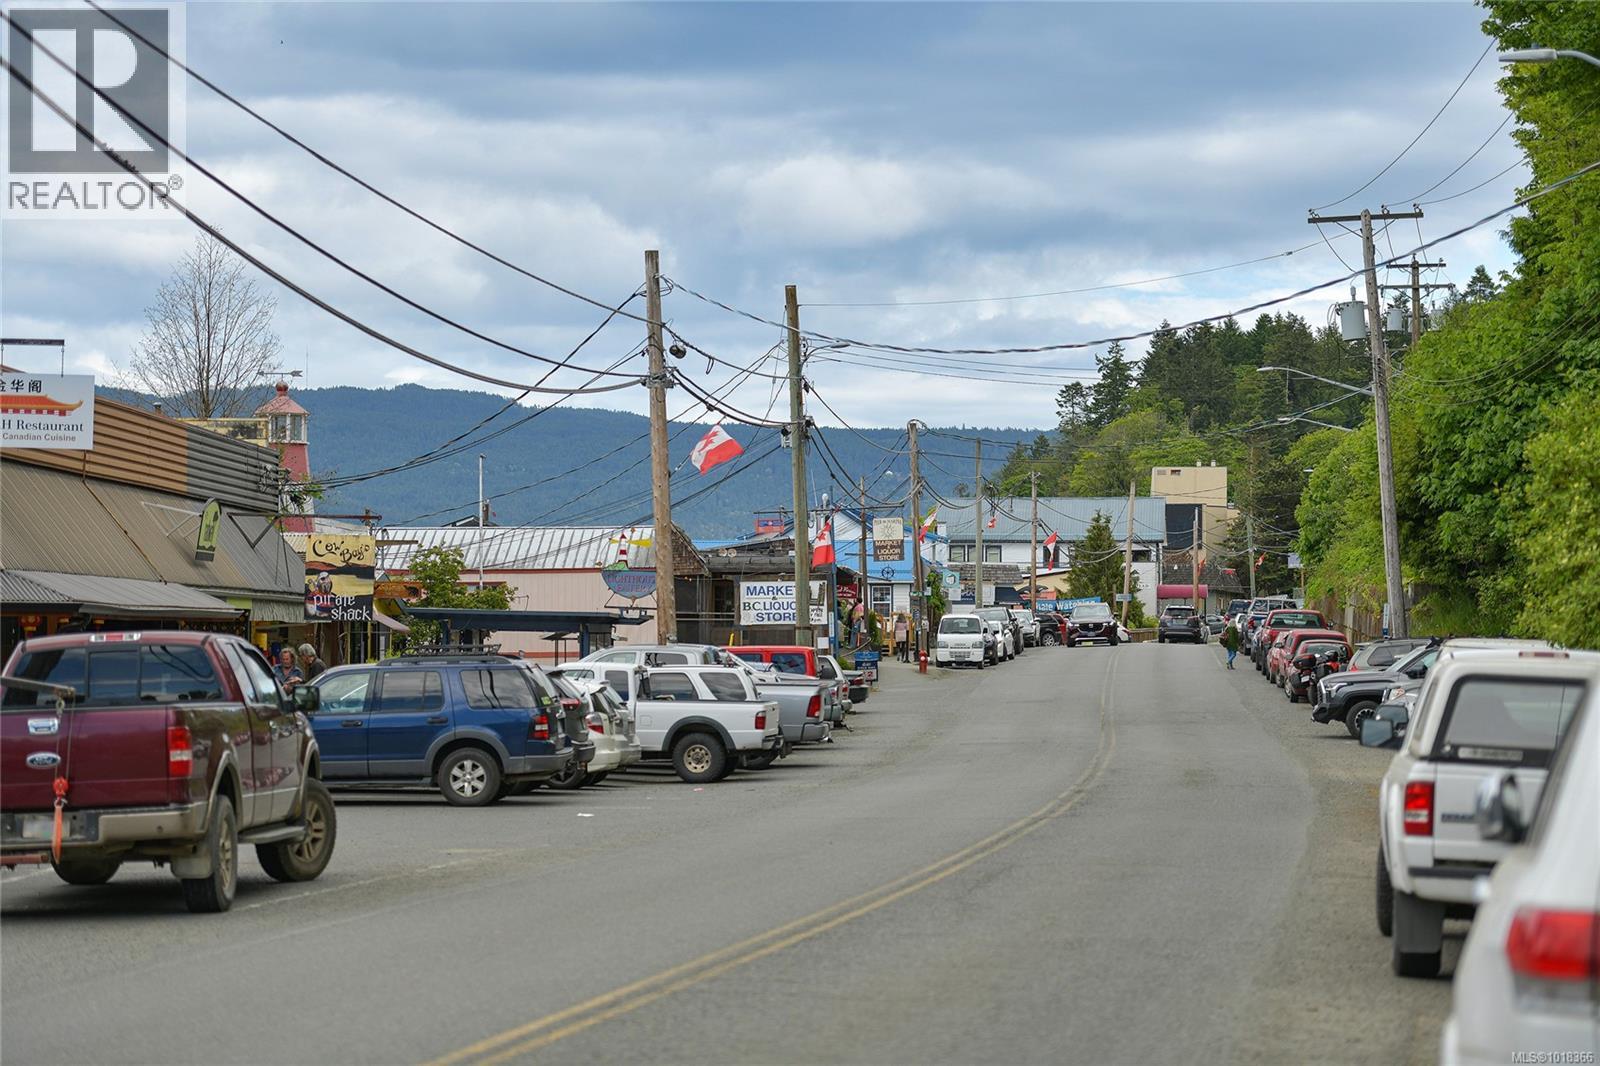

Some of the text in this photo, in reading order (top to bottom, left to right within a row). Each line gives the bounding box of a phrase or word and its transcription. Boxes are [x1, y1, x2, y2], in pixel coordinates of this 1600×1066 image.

[17, 419, 84, 432] Restaurant
[2, 432, 76, 442] Canadian Cuisine
[312, 539, 345, 557] Cow
[746, 585, 797, 596] MARKE
[313, 593, 356, 611] pirate
[763, 601, 797, 612] LIQUO
[331, 605, 372, 621] shack
